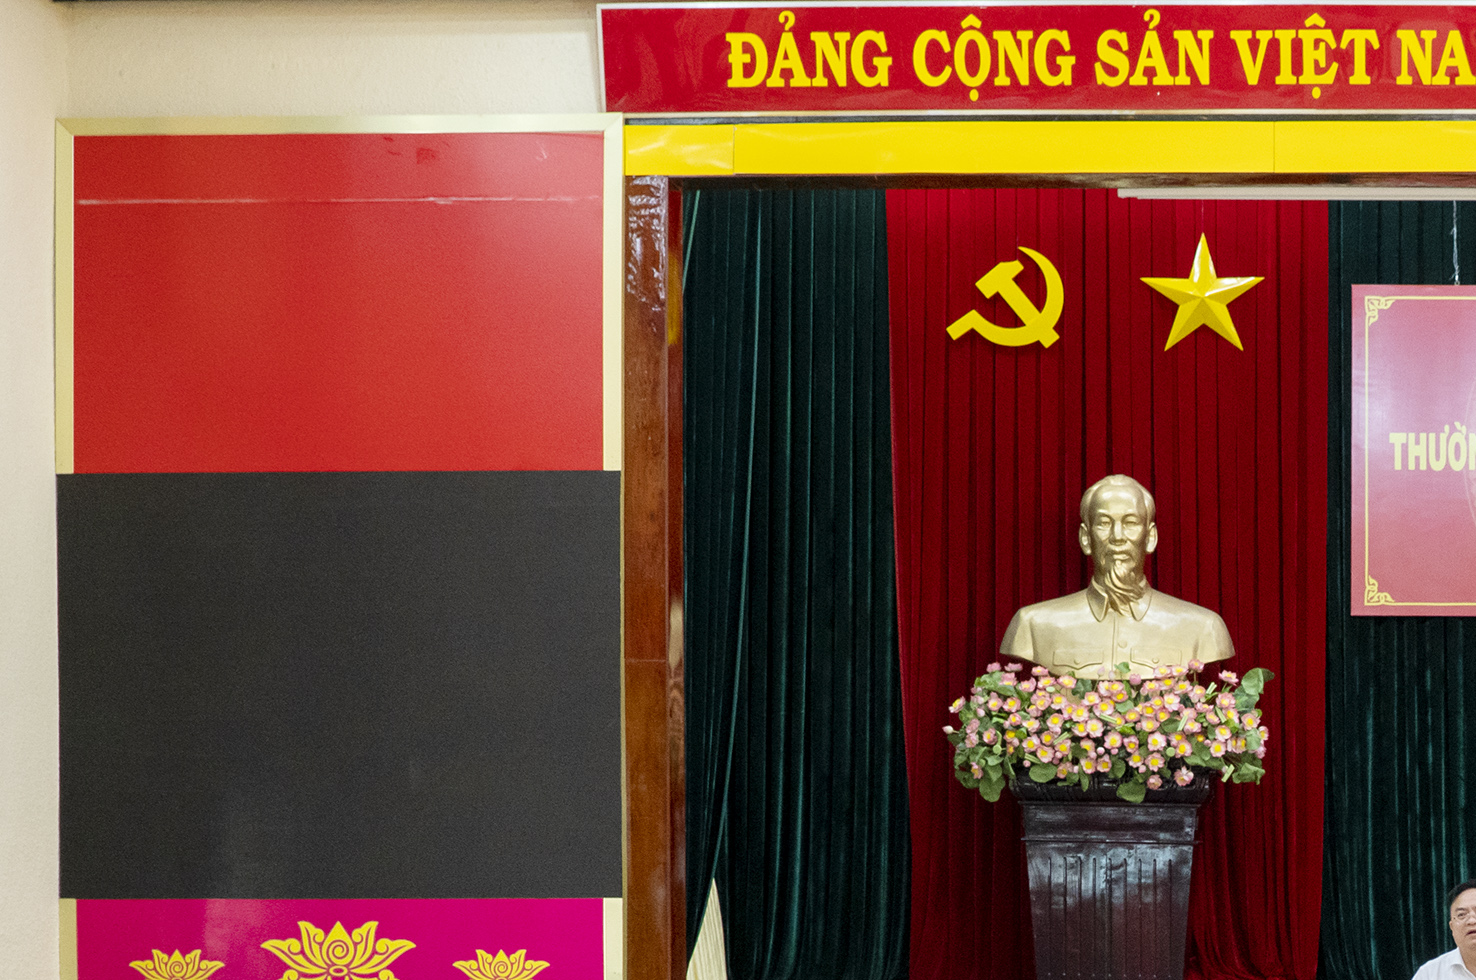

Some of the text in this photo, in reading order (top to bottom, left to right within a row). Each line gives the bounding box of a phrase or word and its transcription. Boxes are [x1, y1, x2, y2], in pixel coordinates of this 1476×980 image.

[726, 11, 892, 87] ĐẢNG
[913, 15, 1075, 101] CỘNG
[1095, 10, 1213, 87] SẢN
[1230, 13, 1379, 99] VIỆT
